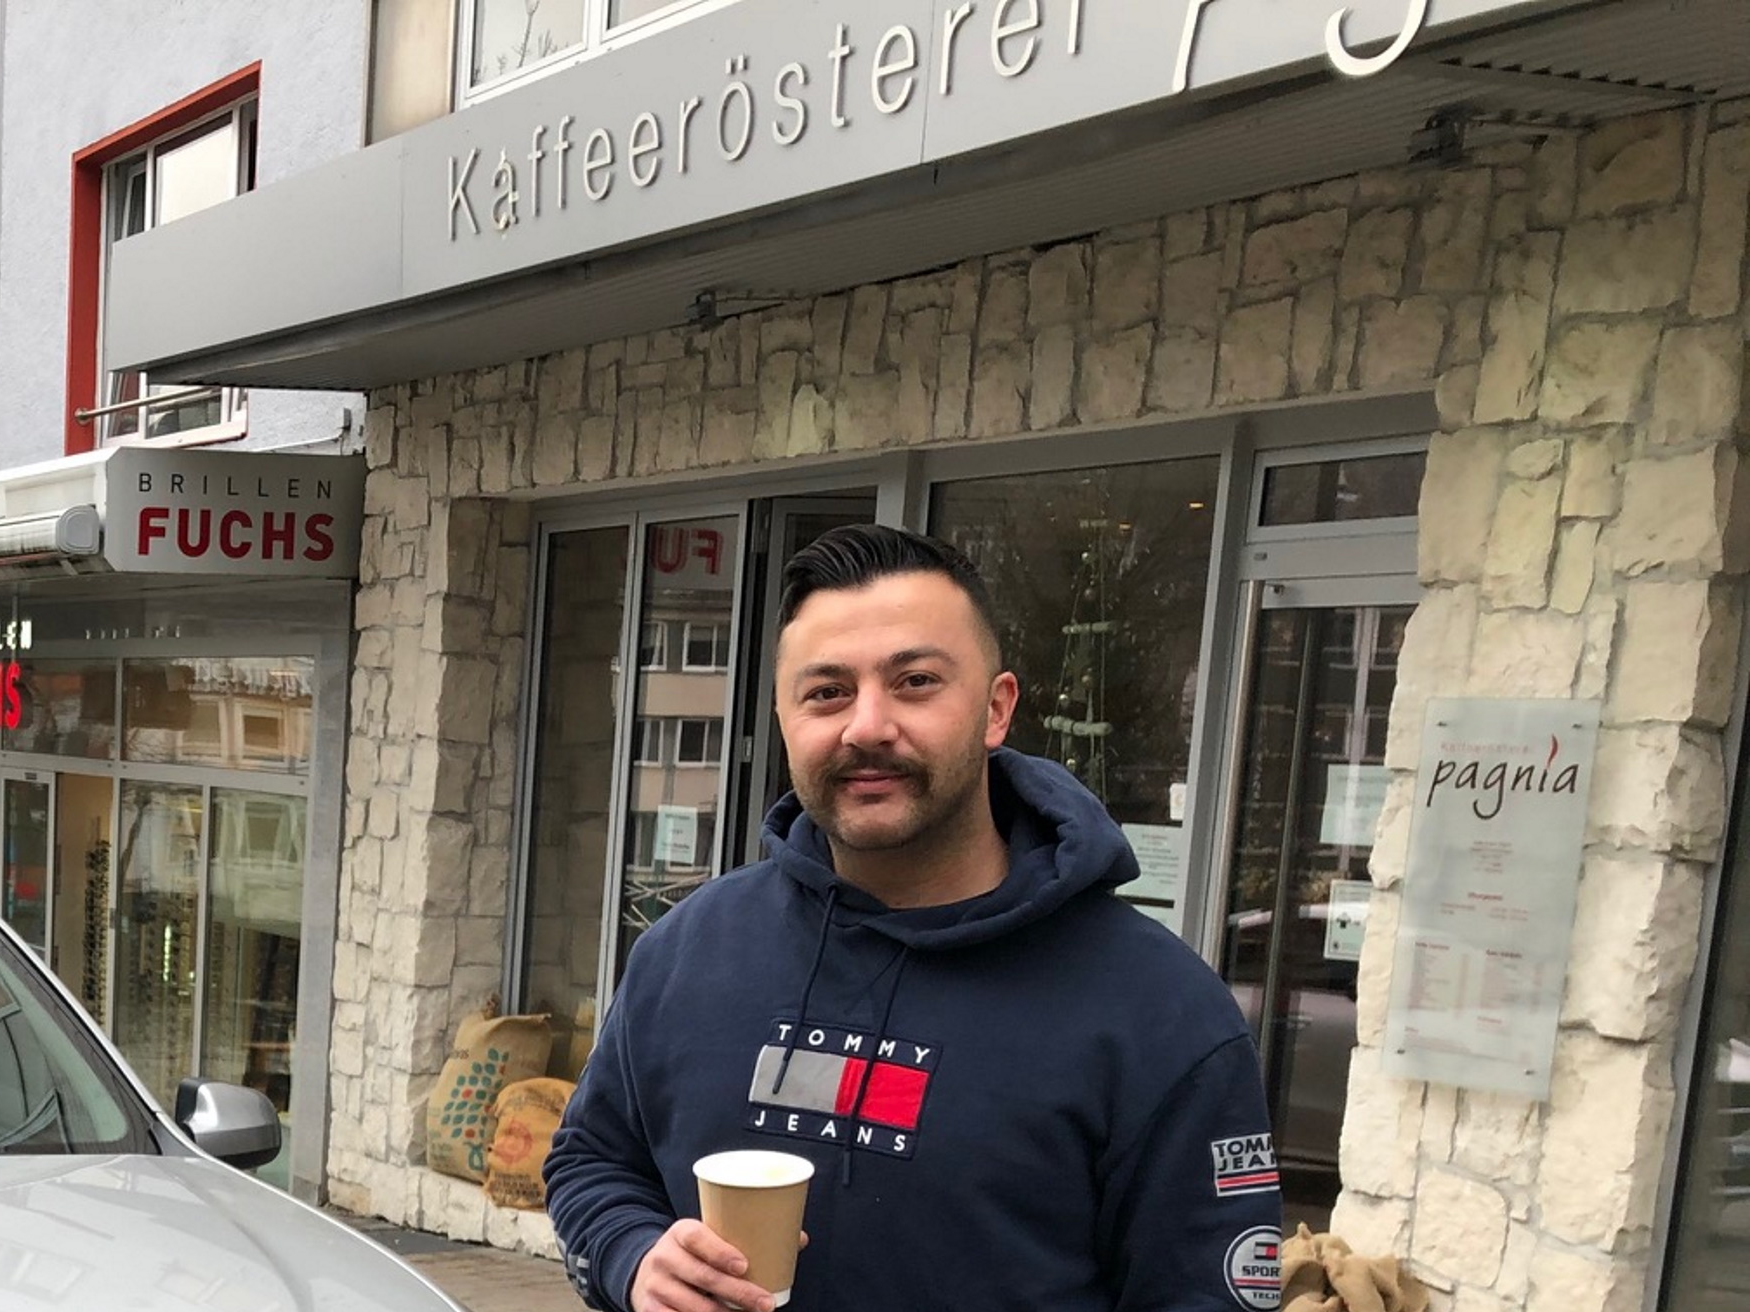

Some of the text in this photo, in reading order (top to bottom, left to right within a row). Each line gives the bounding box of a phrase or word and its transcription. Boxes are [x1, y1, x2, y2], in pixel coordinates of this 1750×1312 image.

[138, 472, 332, 499] BRILLEN
[138, 507, 334, 561] FUCHS
[1426, 734, 1579, 820] pagnia
[778, 1024, 930, 1064] TOMMY
[755, 1111, 906, 1151] JEANS
[1242, 1265, 1282, 1277] SPOR
